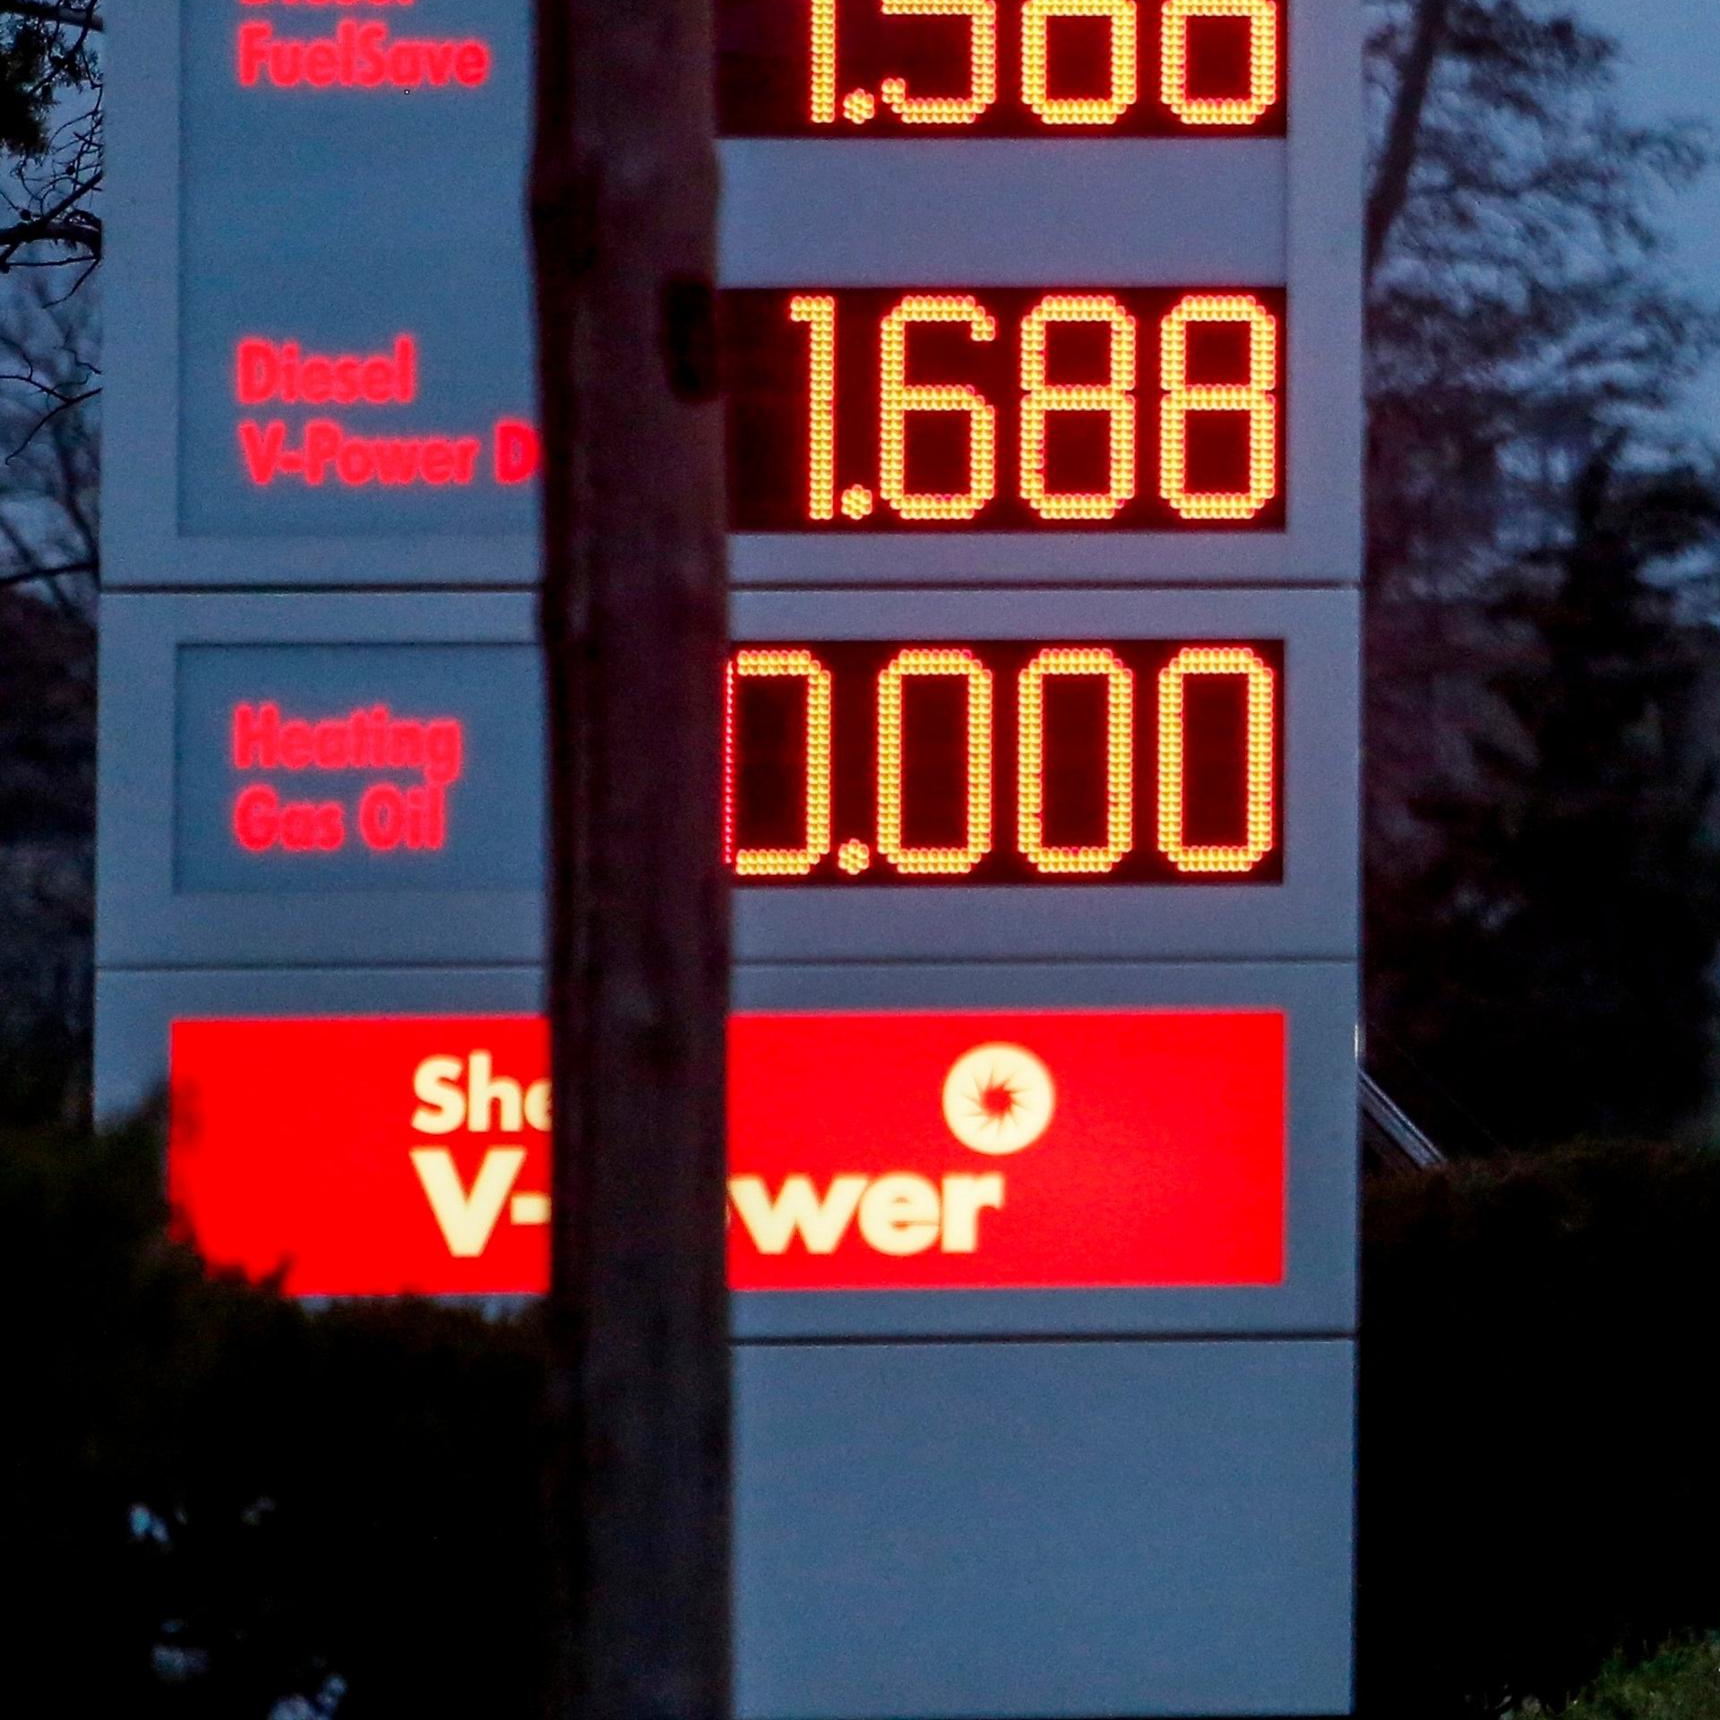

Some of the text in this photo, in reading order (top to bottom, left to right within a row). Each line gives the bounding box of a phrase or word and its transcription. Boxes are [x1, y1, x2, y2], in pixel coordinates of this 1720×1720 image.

[237, 17, 491, 89] FuelSave
[235, 334, 416, 406] Diesel
[789, 294, 1278, 521] 1.688
[238, 418, 482, 486] V-Power
[232, 701, 464, 784] Heating
[726, 646, 1274, 877] 0.000
[232, 779, 449, 852] Gas Oil
[411, 1049, 552, 1135] She
[408, 1146, 1006, 1258] V-wer
